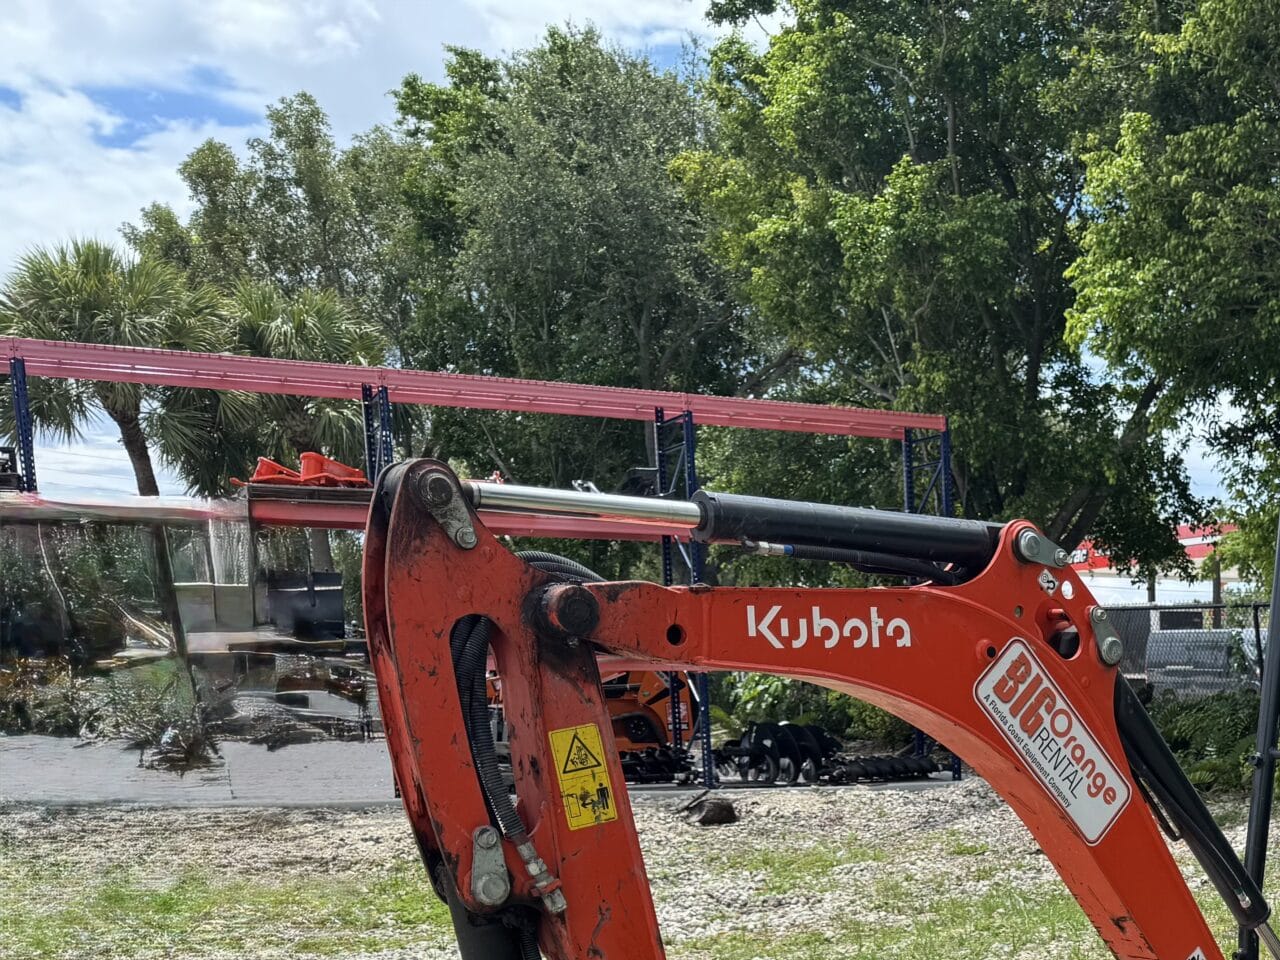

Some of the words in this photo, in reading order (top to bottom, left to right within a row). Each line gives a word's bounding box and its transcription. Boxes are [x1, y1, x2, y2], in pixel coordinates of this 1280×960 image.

[746, 605, 912, 649] Kubota
[983, 693, 992, 703] A
[988, 699, 1009, 727] Florida
[1007, 723, 1025, 746] Coast
[1021, 742, 1051, 780] Equipment
[1047, 776, 1072, 808] Company
[992, 651, 1057, 739] BIG
[1049, 707, 1117, 805] Orange
[1032, 726, 1084, 799] RENTAL
